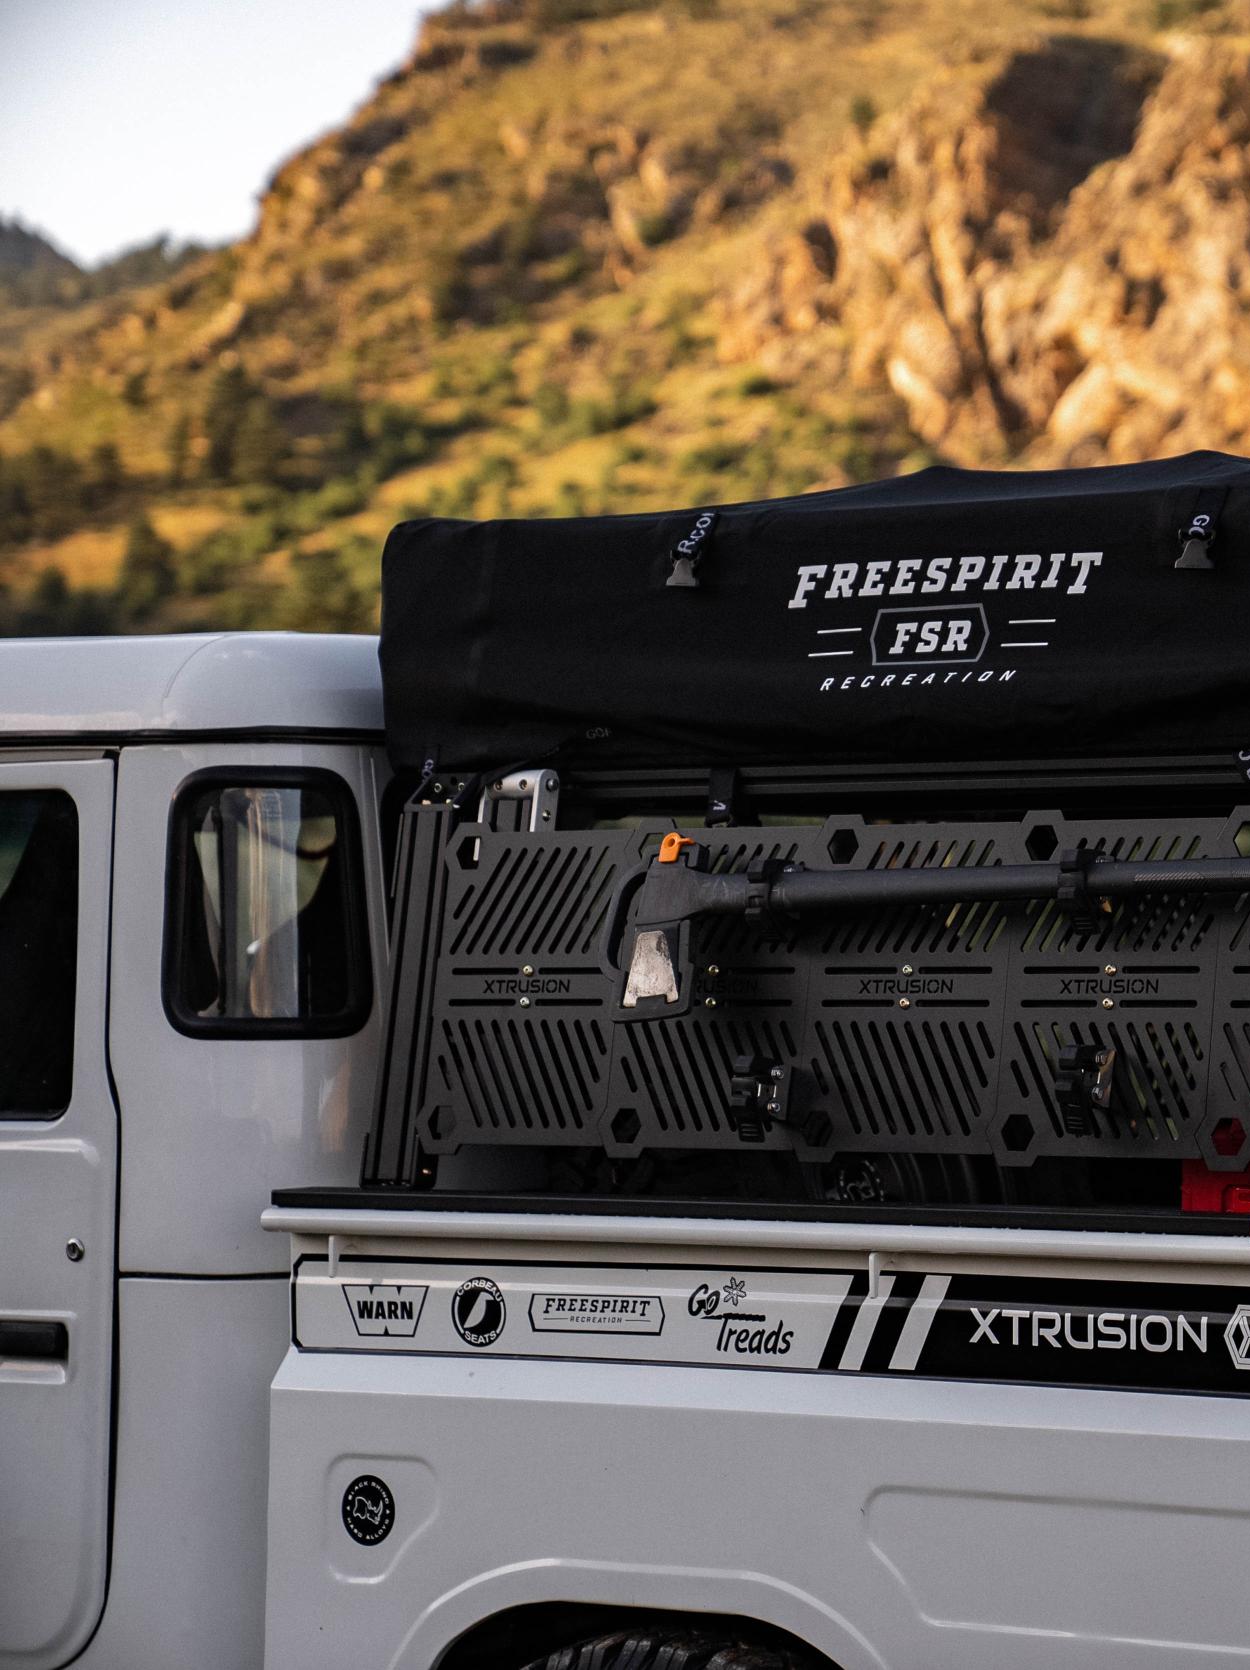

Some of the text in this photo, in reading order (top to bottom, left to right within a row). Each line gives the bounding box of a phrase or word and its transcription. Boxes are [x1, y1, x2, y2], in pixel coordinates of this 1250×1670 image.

[788, 552, 1103, 608] FREESPIRIT
[889, 620, 972, 655] FSR
[820, 669, 1017, 691] RECREATION
[483, 979, 571, 994] XTRUSION
[859, 979, 954, 994] XTRUSION
[1060, 979, 1159, 994] XTRUSION
[457, 1279, 503, 1302] CORBEAU
[688, 1283, 721, 1317] Go
[357, 1300, 414, 1320] WARN
[543, 1298, 650, 1317] FREESPIRIT
[570, 1314, 623, 1324] RECREATION
[463, 1330, 498, 1344] SEATS
[701, 1312, 794, 1355] Treads
[969, 1307, 1208, 1353] XTRUSION
